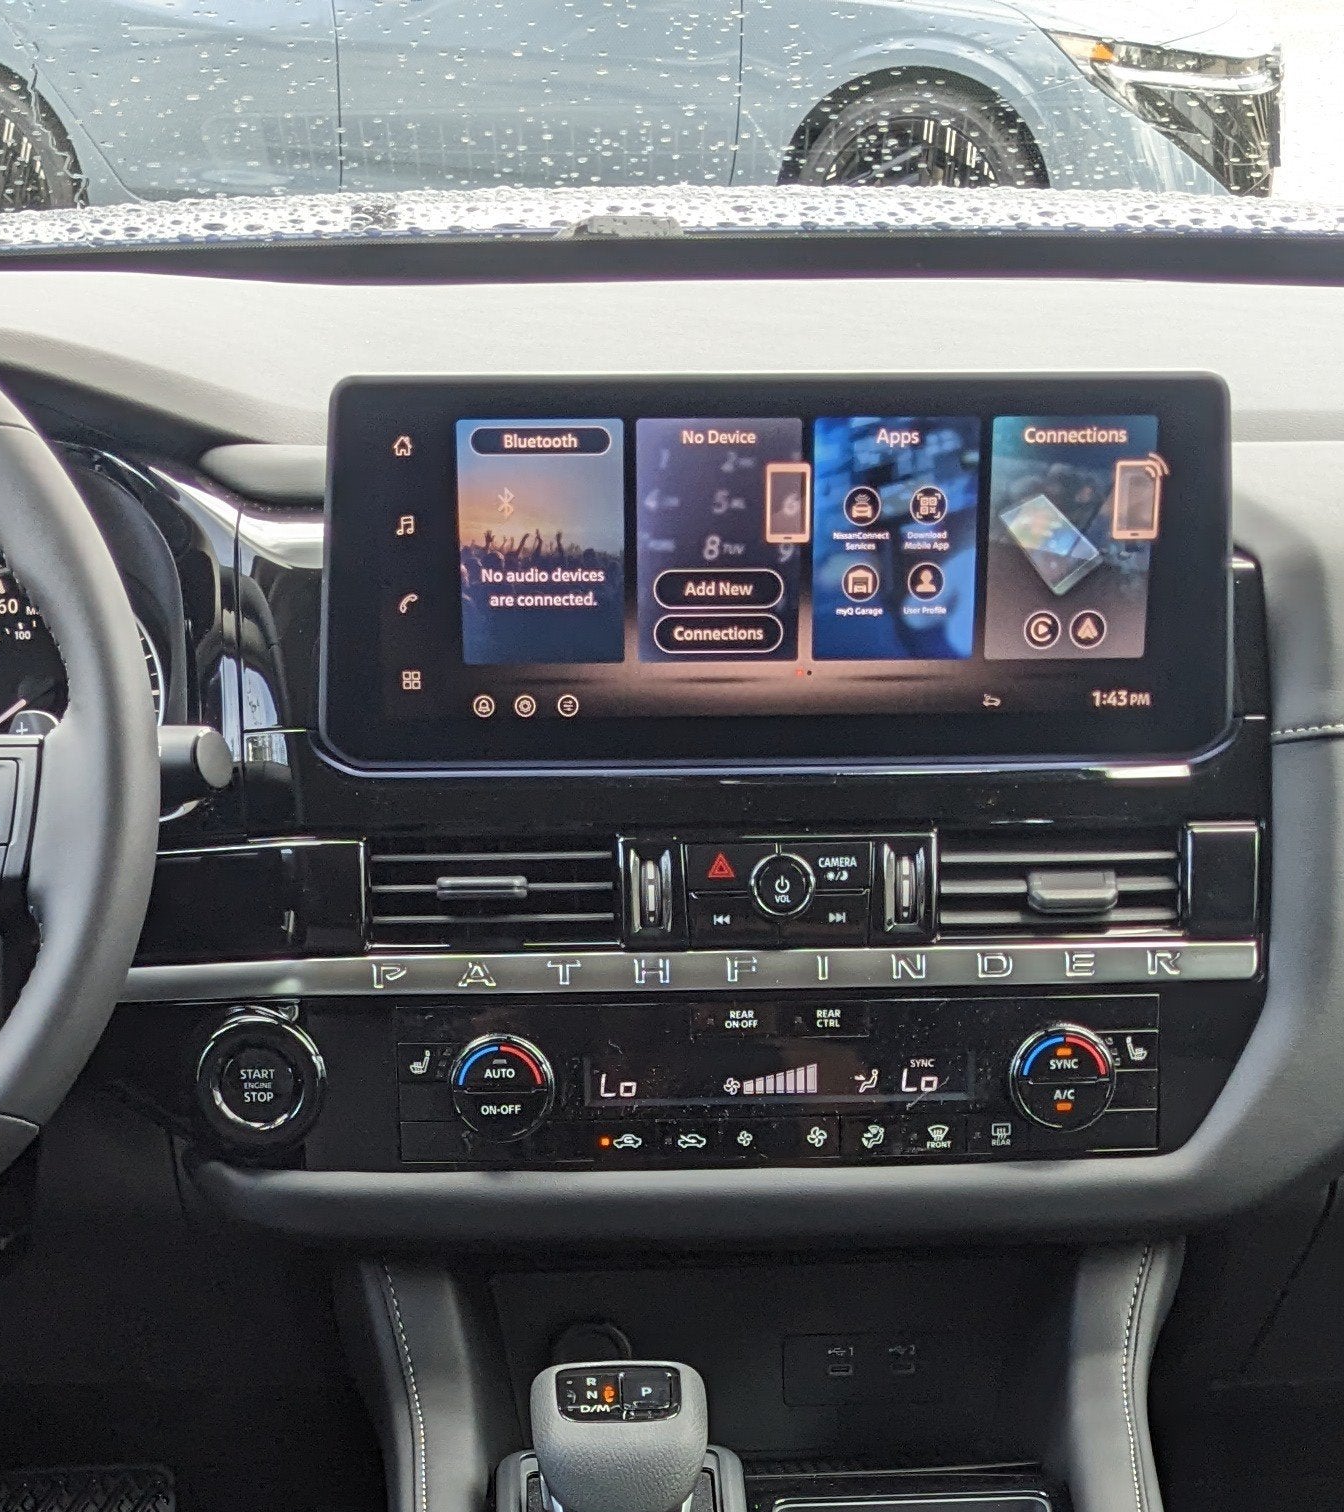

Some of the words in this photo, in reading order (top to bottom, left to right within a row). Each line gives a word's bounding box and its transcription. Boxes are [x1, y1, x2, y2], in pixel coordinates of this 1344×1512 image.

[682, 431, 704, 444] No
[708, 430, 757, 445] Device
[876, 429, 920, 448] Apps
[1024, 427, 1128, 444] Connections
[503, 433, 578, 449] Bluetooth
[832, 531, 890, 540] NissanConnect
[907, 531, 947, 539] Download
[703, 535, 721, 561] 8
[845, 541, 876, 550] Services
[904, 541, 929, 550] Mobile
[931, 541, 950, 551] App
[480, 568, 503, 583] No
[506, 567, 549, 583] audio
[552, 567, 605, 583] devices
[684, 582, 715, 597] Add
[719, 582, 753, 597] New
[490, 595, 514, 607] are
[517, 592, 598, 607] connected.
[836, 607, 852, 617] myQ
[854, 607, 883, 617] Garage
[903, 606, 921, 614] User
[922, 605, 947, 614] Profile
[14, 630, 31, 640] 100
[673, 625, 764, 641] Connections
[1092, 690, 1128, 707] 1:43
[1130, 692, 1151, 707] PM
[818, 857, 857, 868] CAMERA
[774, 895, 792, 904] VOL
[371, 950, 1181, 989] PATHFINDER
[729, 1010, 755, 1019] REAR
[816, 1009, 841, 1018] REAR
[724, 1019, 758, 1029] ON-OFF
[816, 1019, 841, 1028] CTRL
[909, 1058, 935, 1068] SYNC
[1050, 1059, 1079, 1071] SYNC
[240, 1069, 276, 1080] START
[484, 1068, 516, 1079] AUTO
[244, 1091, 274, 1103] STOP
[1053, 1089, 1075, 1101] A/C
[481, 1104, 521, 1116] ON-OFF
[926, 1141, 952, 1150] FRONT
[991, 1138, 1011, 1146] REAR
[586, 1377, 597, 1387] R
[586, 1390, 599, 1400] N
[641, 1387, 653, 1397] P
[579, 1404, 611, 1413] D/M
